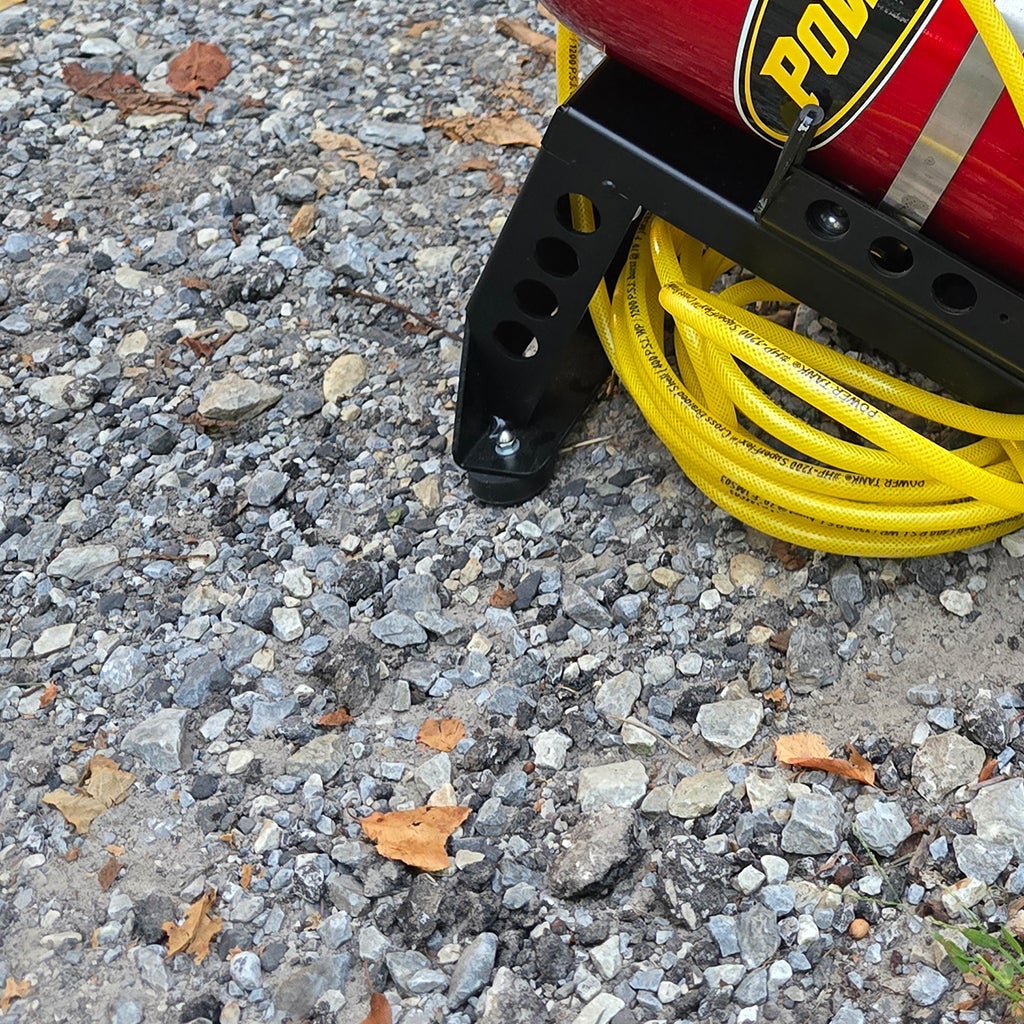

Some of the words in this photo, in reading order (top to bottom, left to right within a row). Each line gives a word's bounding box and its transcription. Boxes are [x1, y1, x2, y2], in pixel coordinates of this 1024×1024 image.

[660, 371, 677, 393] Shell
[829, 383, 878, 418] POWER
[704, 415, 732, 439] Cross
